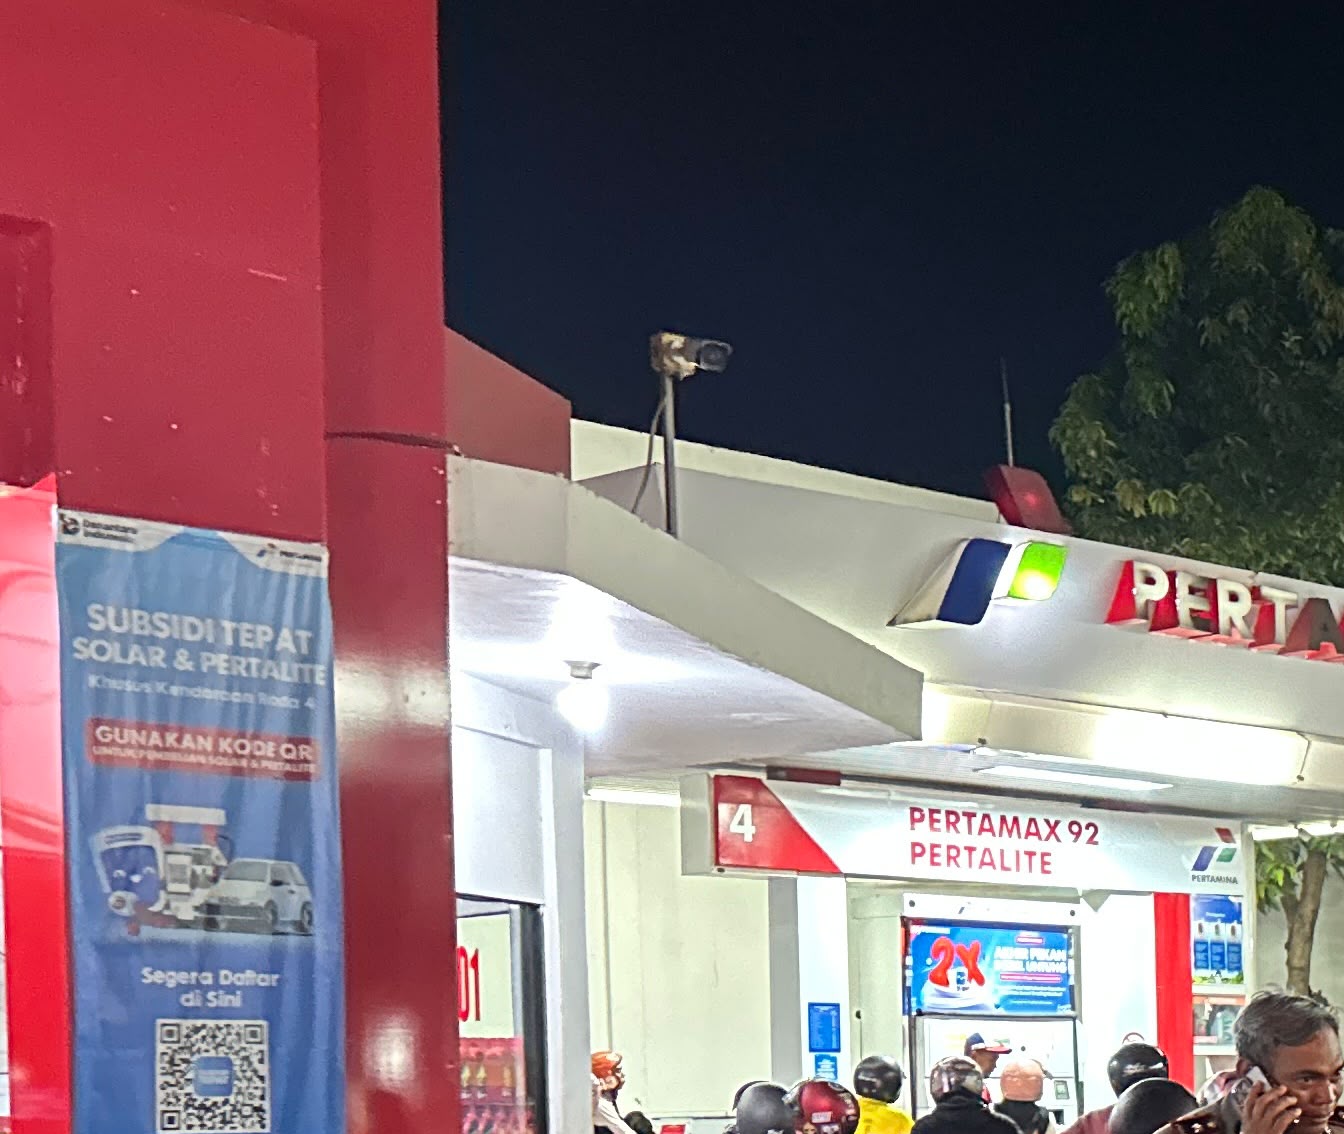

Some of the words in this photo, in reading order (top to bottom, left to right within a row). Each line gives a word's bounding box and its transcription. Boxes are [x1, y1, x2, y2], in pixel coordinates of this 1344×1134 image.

[87, 603, 213, 642] SUBSIDI
[220, 619, 313, 655] TEPAT
[72, 636, 167, 668] SOLAR
[172, 648, 195, 672] &
[201, 651, 327, 686] PERTALITE
[95, 725, 213, 752] GUNAKAN
[218, 736, 276, 756] KODE
[279, 743, 313, 761] QR
[729, 803, 757, 843] 4
[909, 806, 1062, 844] PERTAMAX
[1067, 821, 1100, 846] 92
[909, 841, 1053, 875] PERTALITE
[1191, 873, 1239, 885] PERTAMINA
[141, 967, 214, 988] Segera
[219, 968, 281, 987] Daftar
[928, 935, 986, 988] 2X
[179, 990, 204, 1008] di
[206, 990, 243, 1008] Sini
